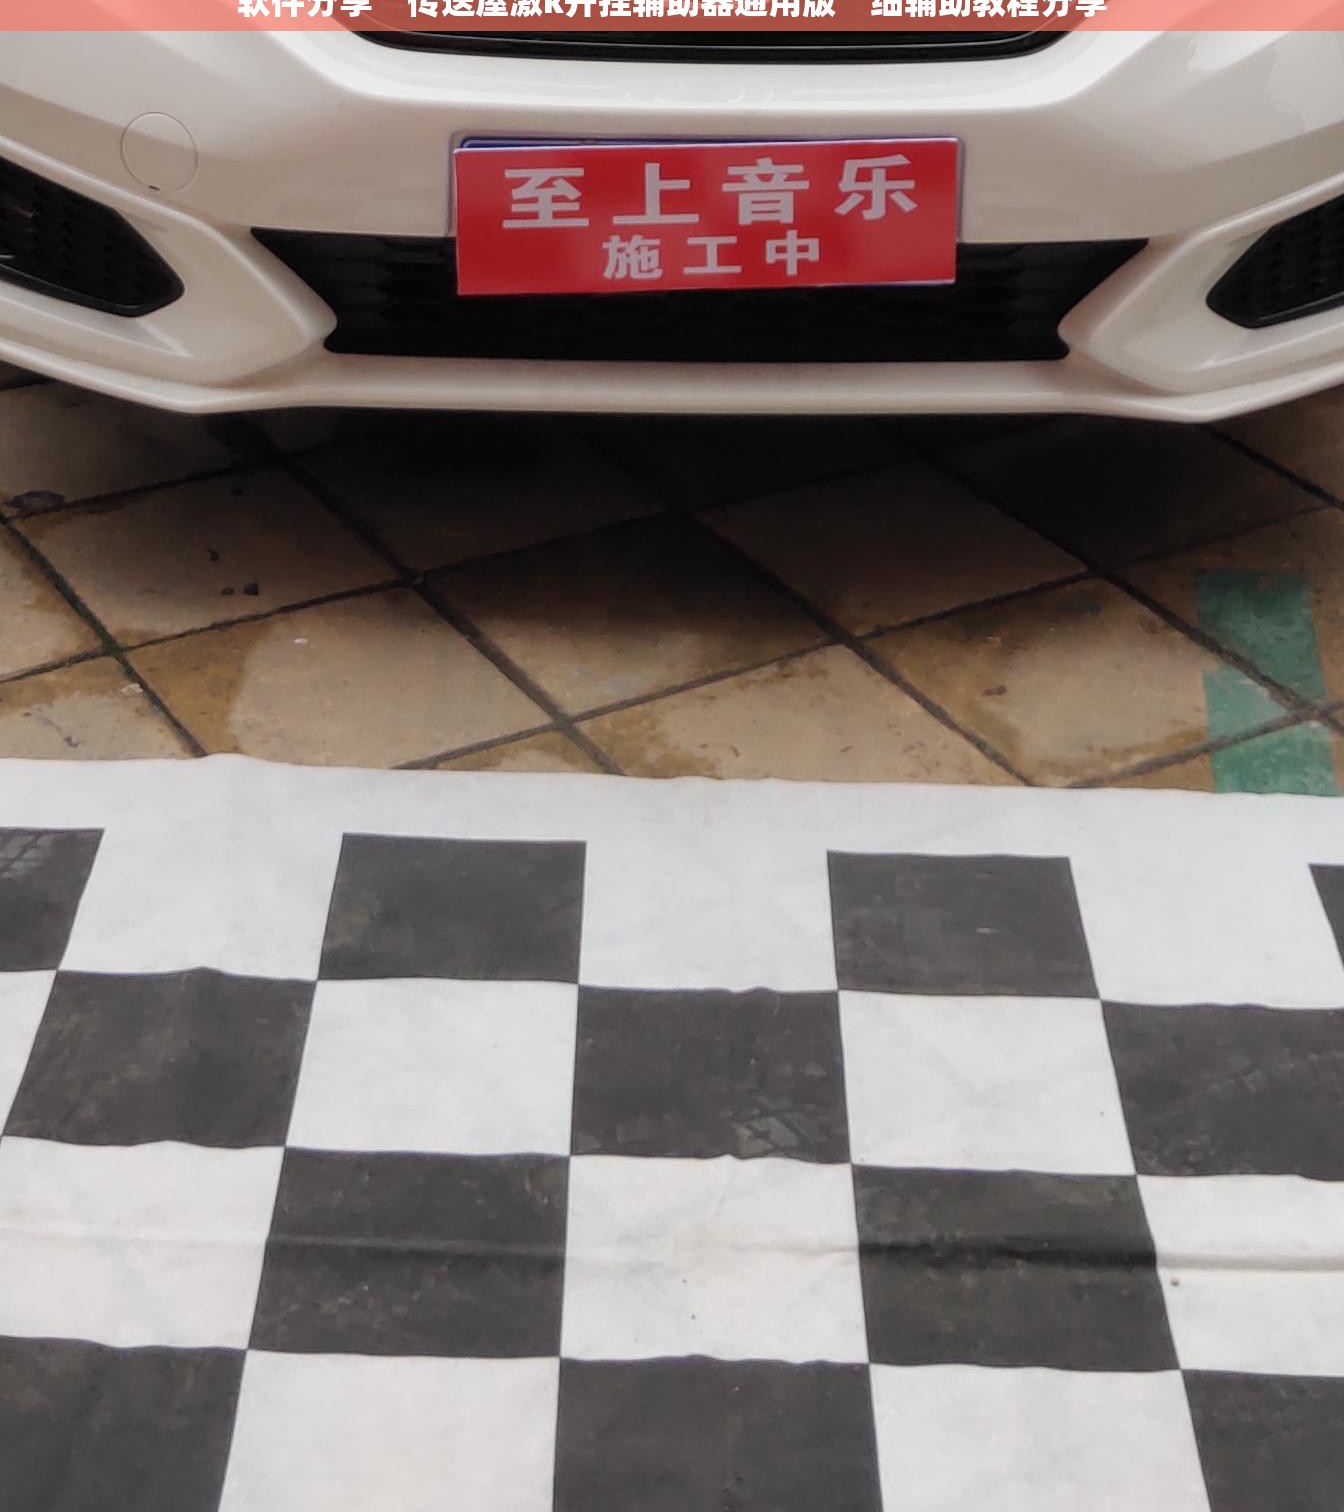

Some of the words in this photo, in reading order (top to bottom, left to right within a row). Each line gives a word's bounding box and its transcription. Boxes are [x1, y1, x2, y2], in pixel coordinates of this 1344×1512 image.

[501, 154, 919, 230] 至上音乐
[602, 229, 821, 280] 施工中
